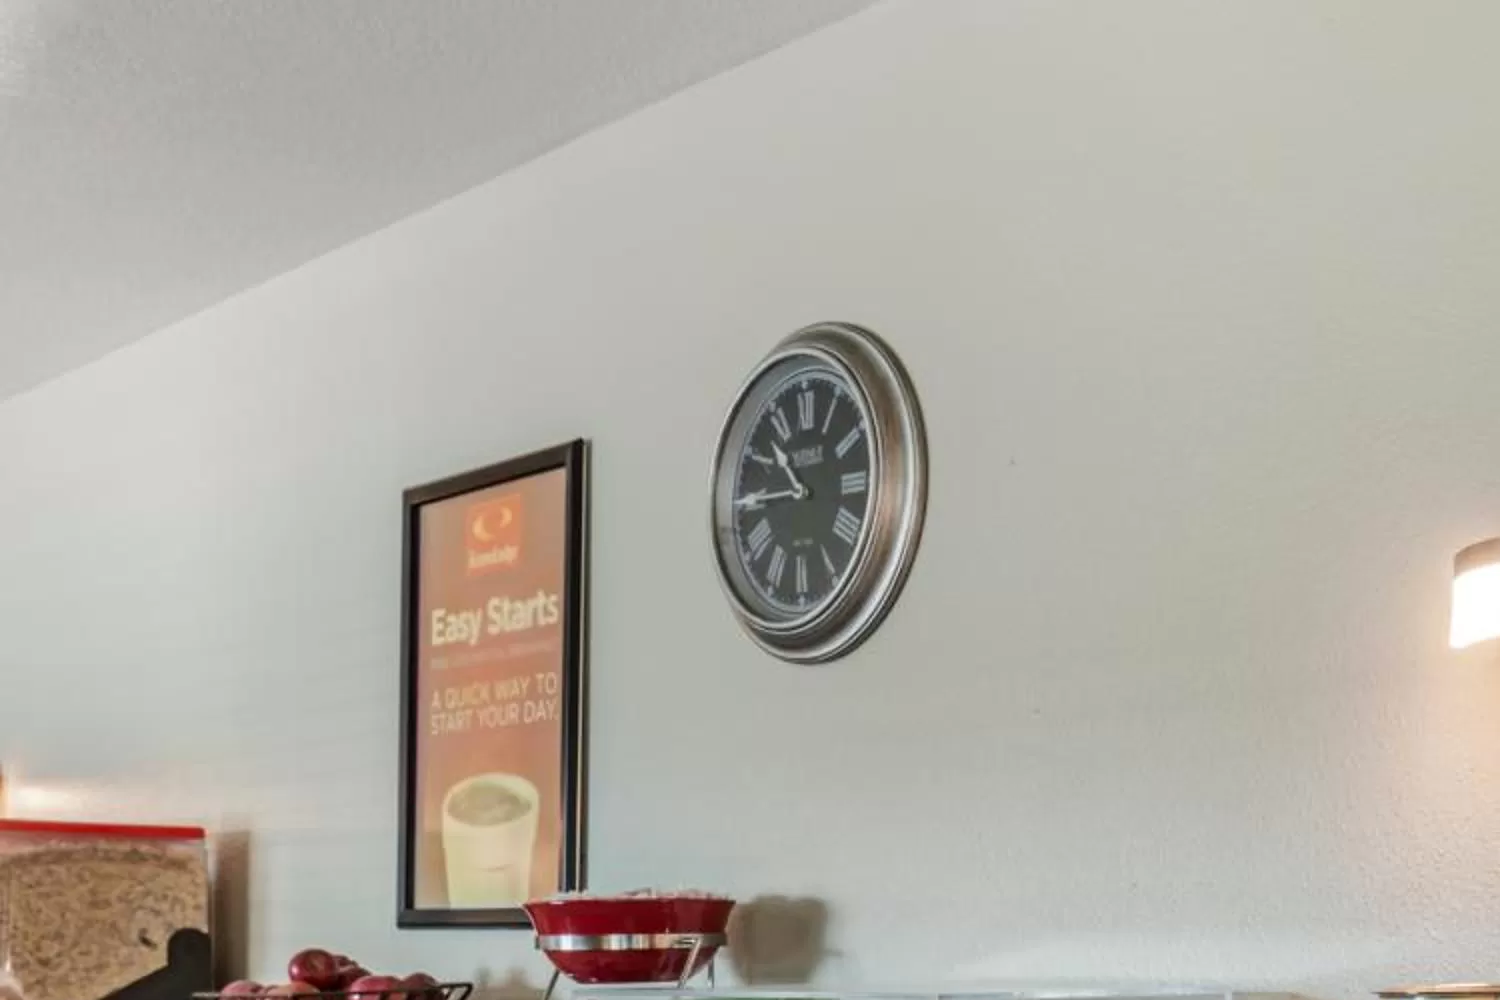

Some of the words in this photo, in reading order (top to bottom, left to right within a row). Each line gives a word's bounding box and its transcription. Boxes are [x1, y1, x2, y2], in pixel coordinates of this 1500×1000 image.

[432, 608, 483, 647] Easy
[487, 590, 559, 635] Starts
[431, 689, 442, 710] A
[445, 680, 491, 709] QUICK
[493, 675, 531, 702] WAY
[535, 671, 558, 695] TO
[431, 709, 473, 736] START
[476, 702, 520, 729] YOUR
